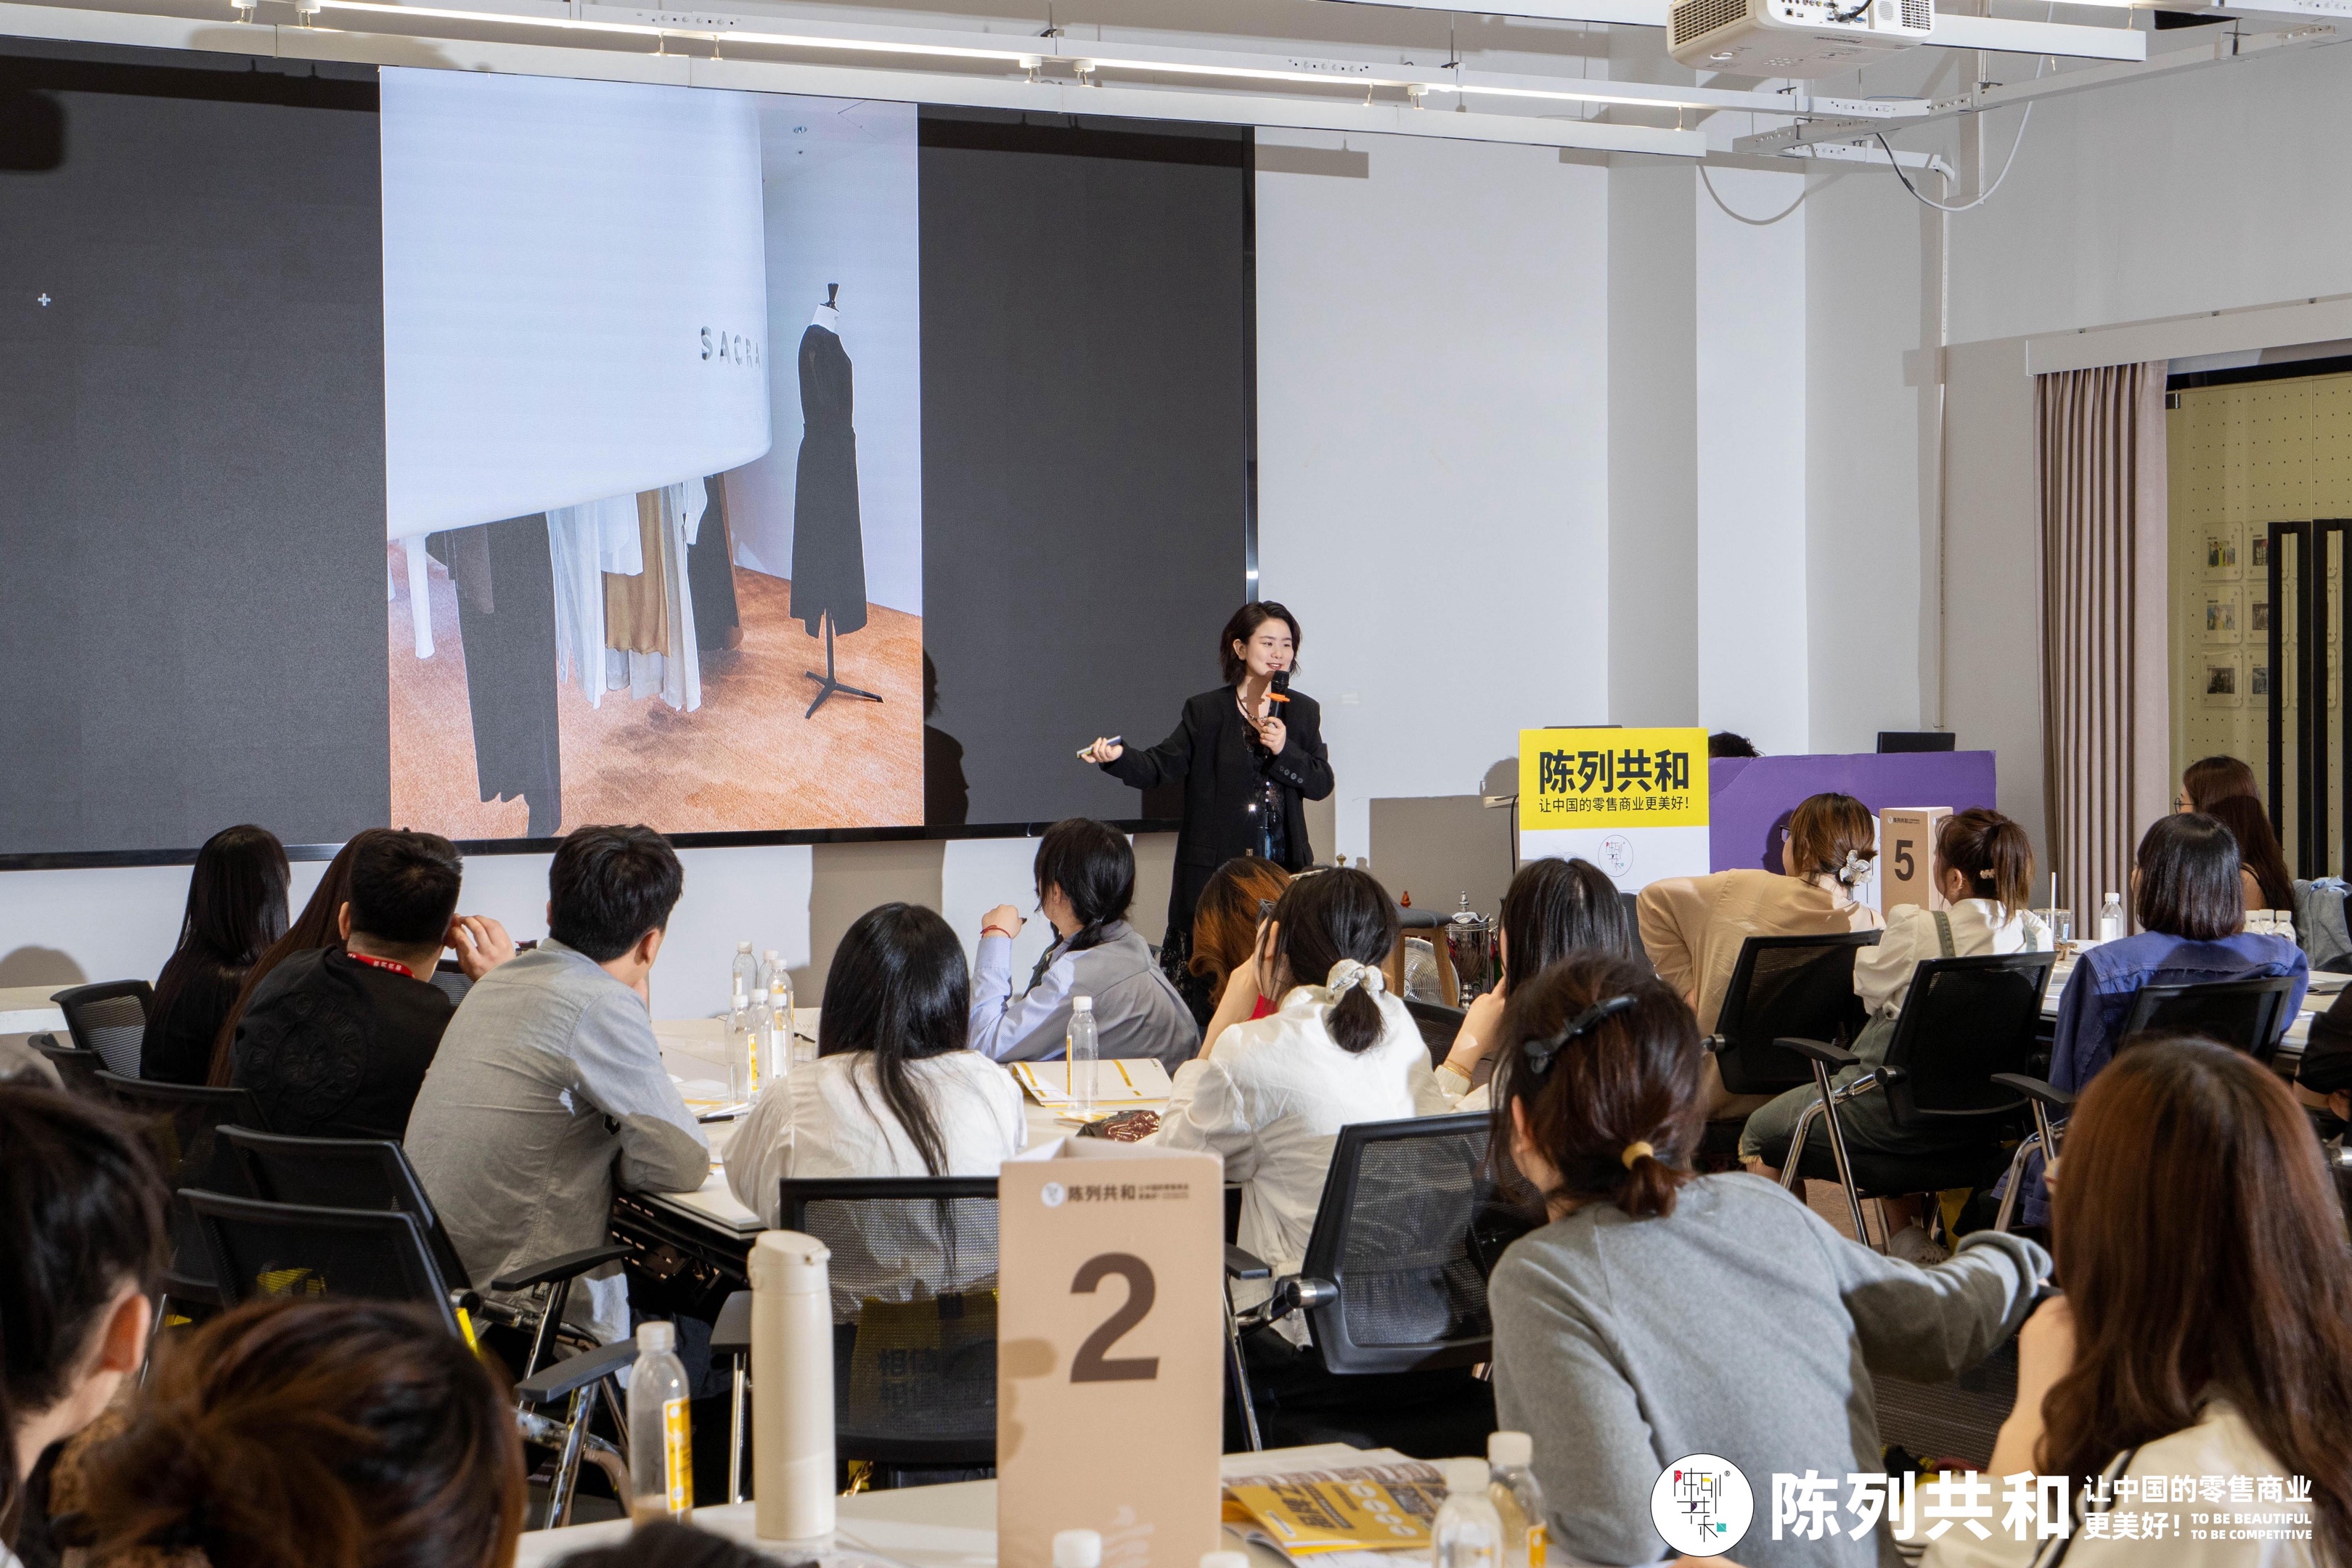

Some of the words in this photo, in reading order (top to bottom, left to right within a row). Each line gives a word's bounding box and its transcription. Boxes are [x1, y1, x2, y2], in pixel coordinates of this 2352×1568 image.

[701, 326, 761, 369] SACRA
[1539, 748, 1689, 794] 陈列共和
[1539, 796, 1689, 813] 让中国的零售商业更美好！
[1894, 839, 1915, 881] 5
[1068, 1184, 1136, 1201] 陈列共和
[1070, 1251, 1160, 1384] 2
